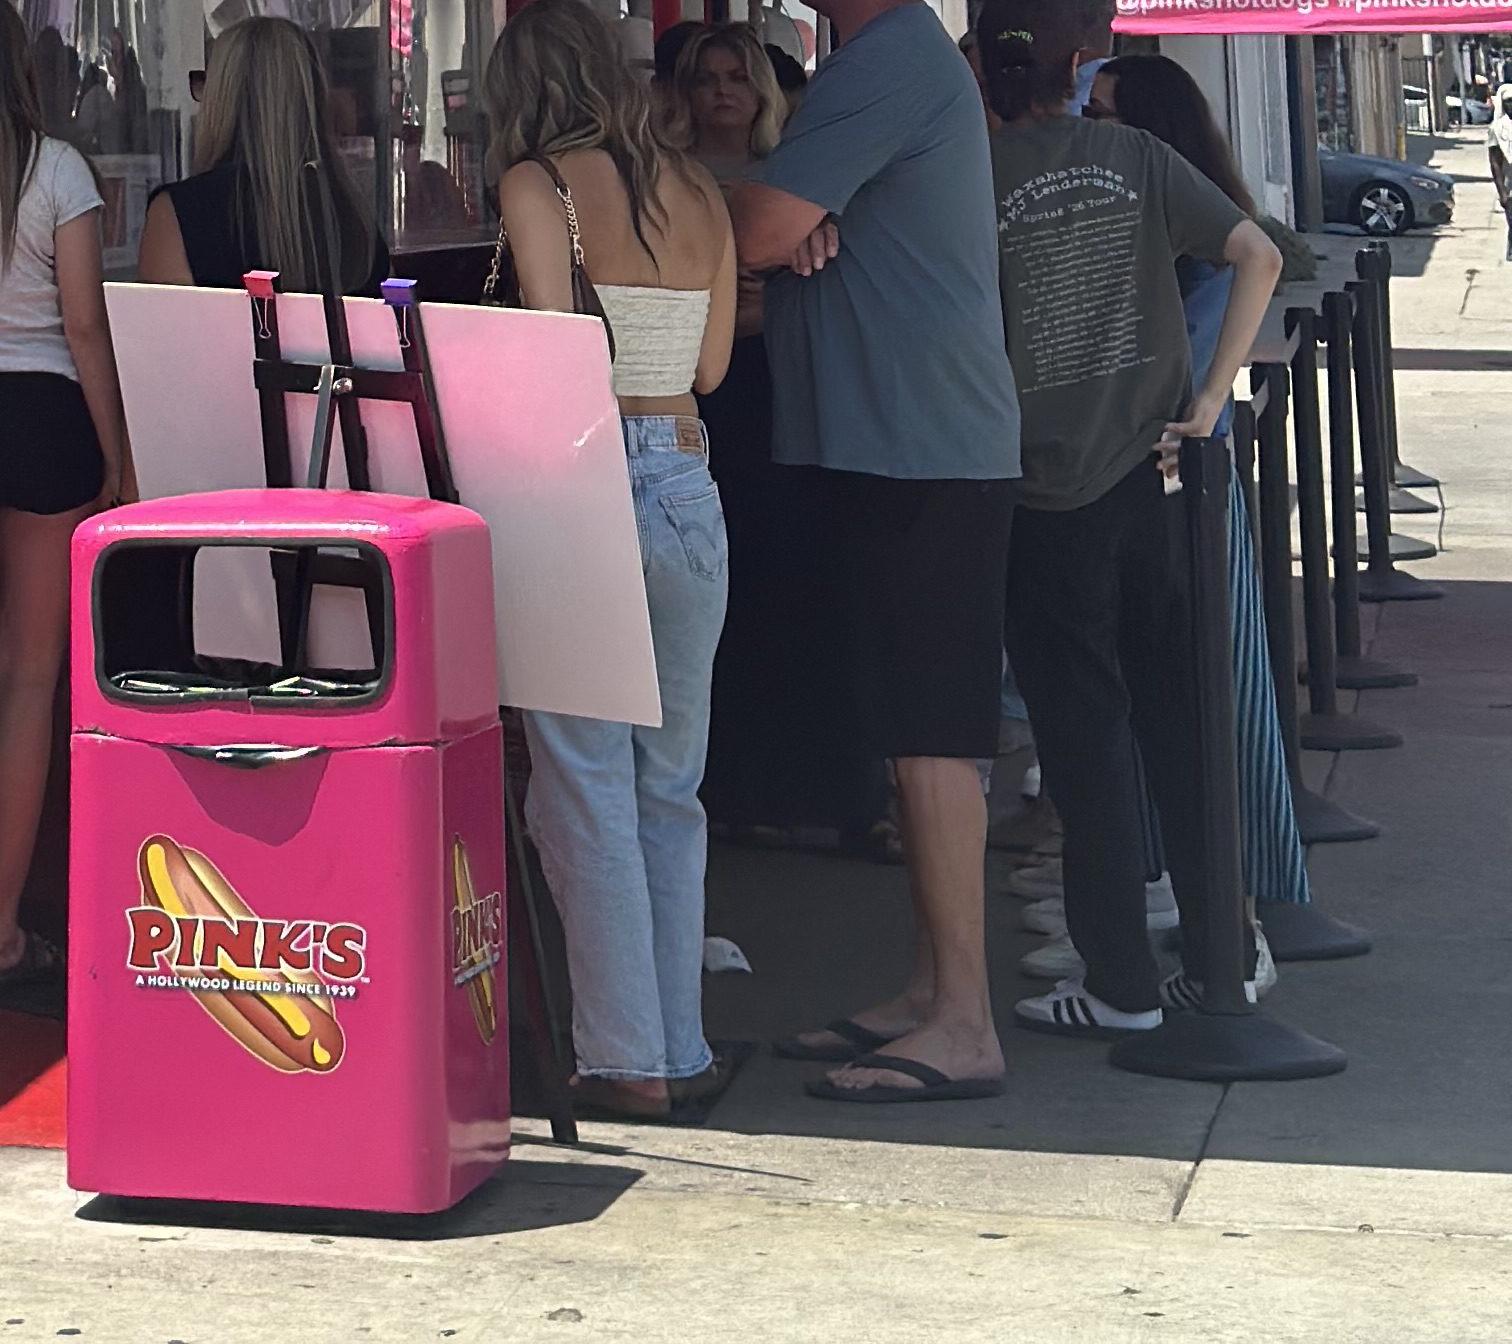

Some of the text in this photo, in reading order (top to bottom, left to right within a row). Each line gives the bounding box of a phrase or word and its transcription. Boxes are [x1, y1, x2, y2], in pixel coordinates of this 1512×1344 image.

[126, 907, 365, 981] PINK'S
[135, 975, 357, 997] A HOLLYWOOD LEGEND SINCE 1939
